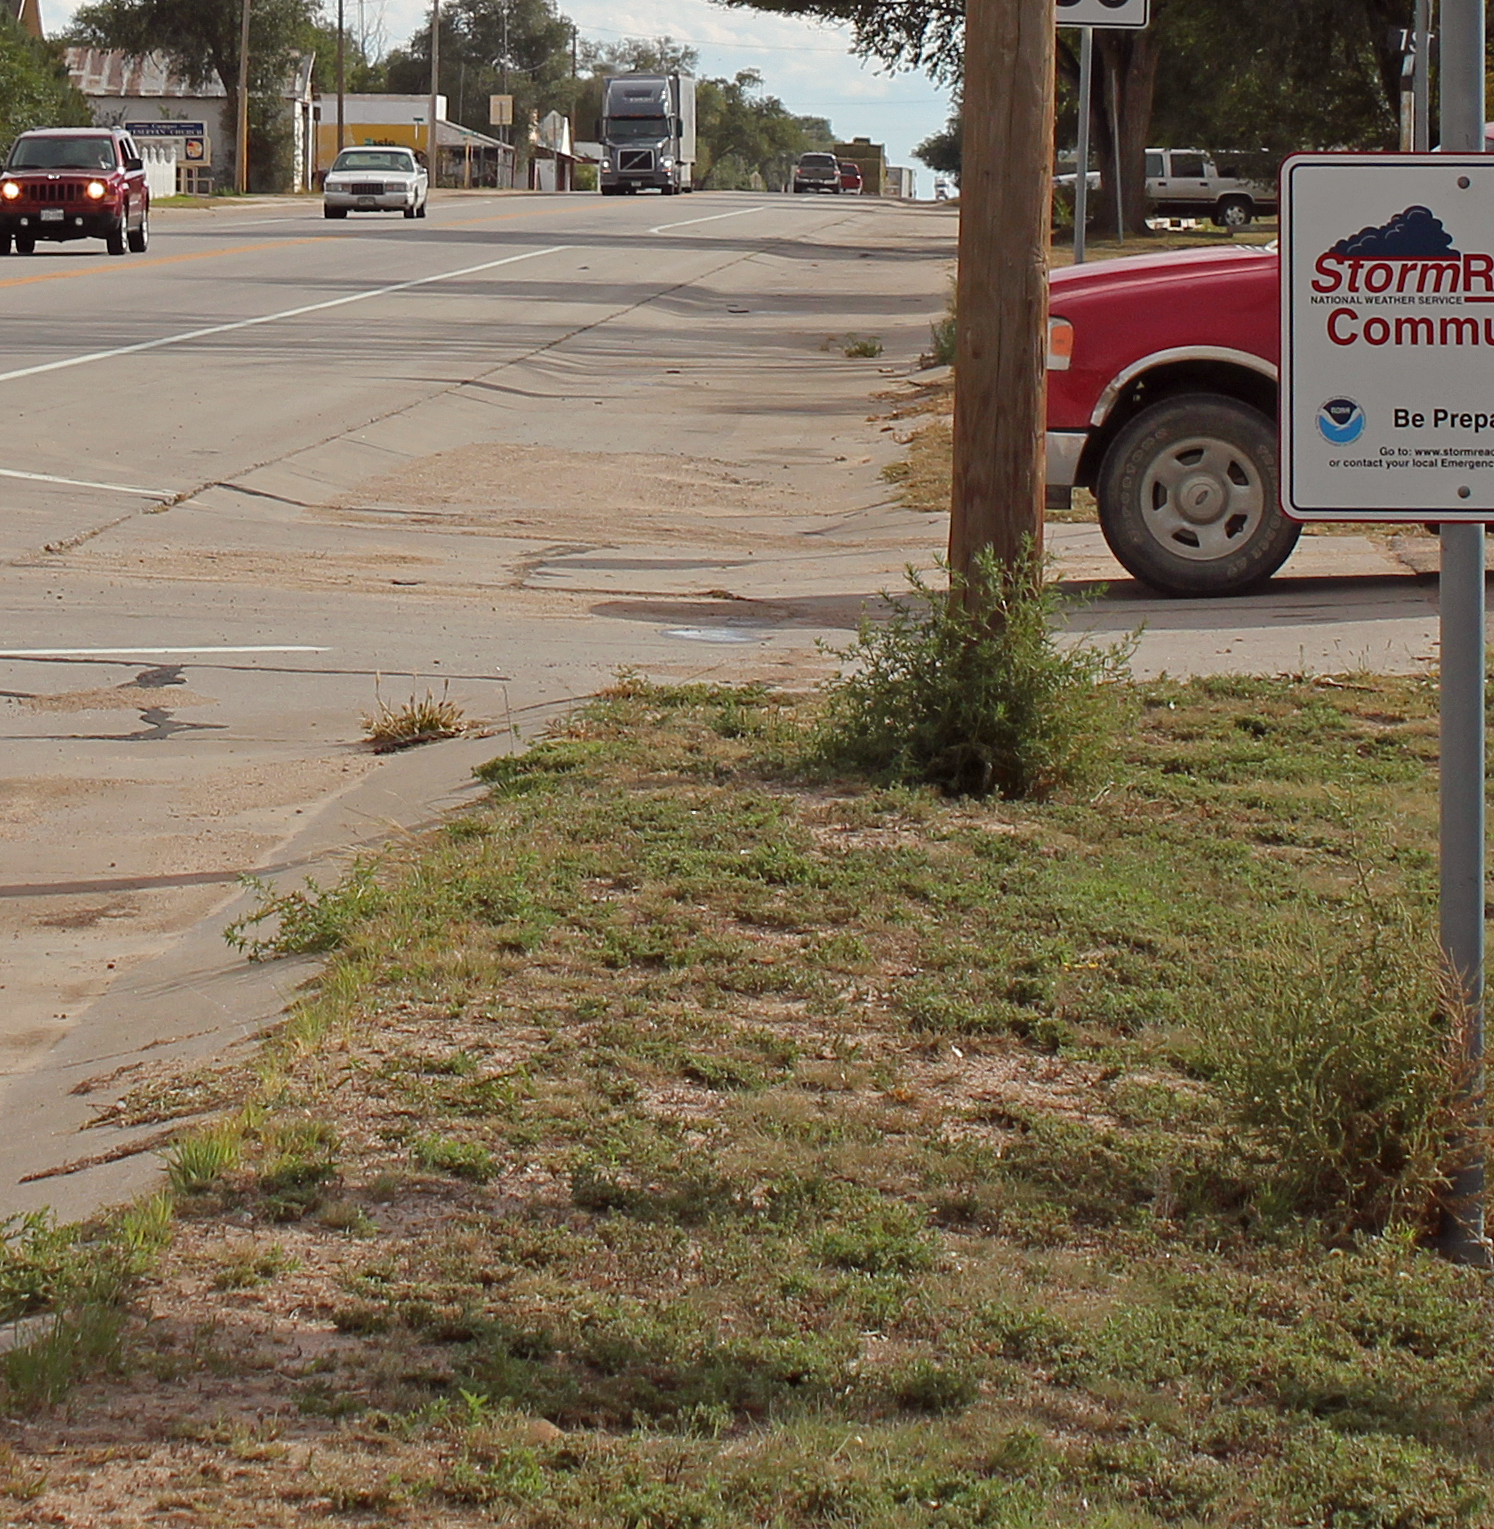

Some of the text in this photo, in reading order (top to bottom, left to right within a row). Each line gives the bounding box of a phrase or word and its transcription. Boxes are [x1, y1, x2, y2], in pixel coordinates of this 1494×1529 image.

[1310, 296, 1464, 305] NATIONAL WEATHER SERVICE
[1393, 408, 1425, 429] Be
[1379, 446, 1395, 457] Go
[1398, 447, 1412, 457] to:
[1328, 459, 1340, 468] or
[1342, 458, 1383, 468] contact
[1385, 459, 1410, 470] your
[1412, 458, 1438, 468] local
